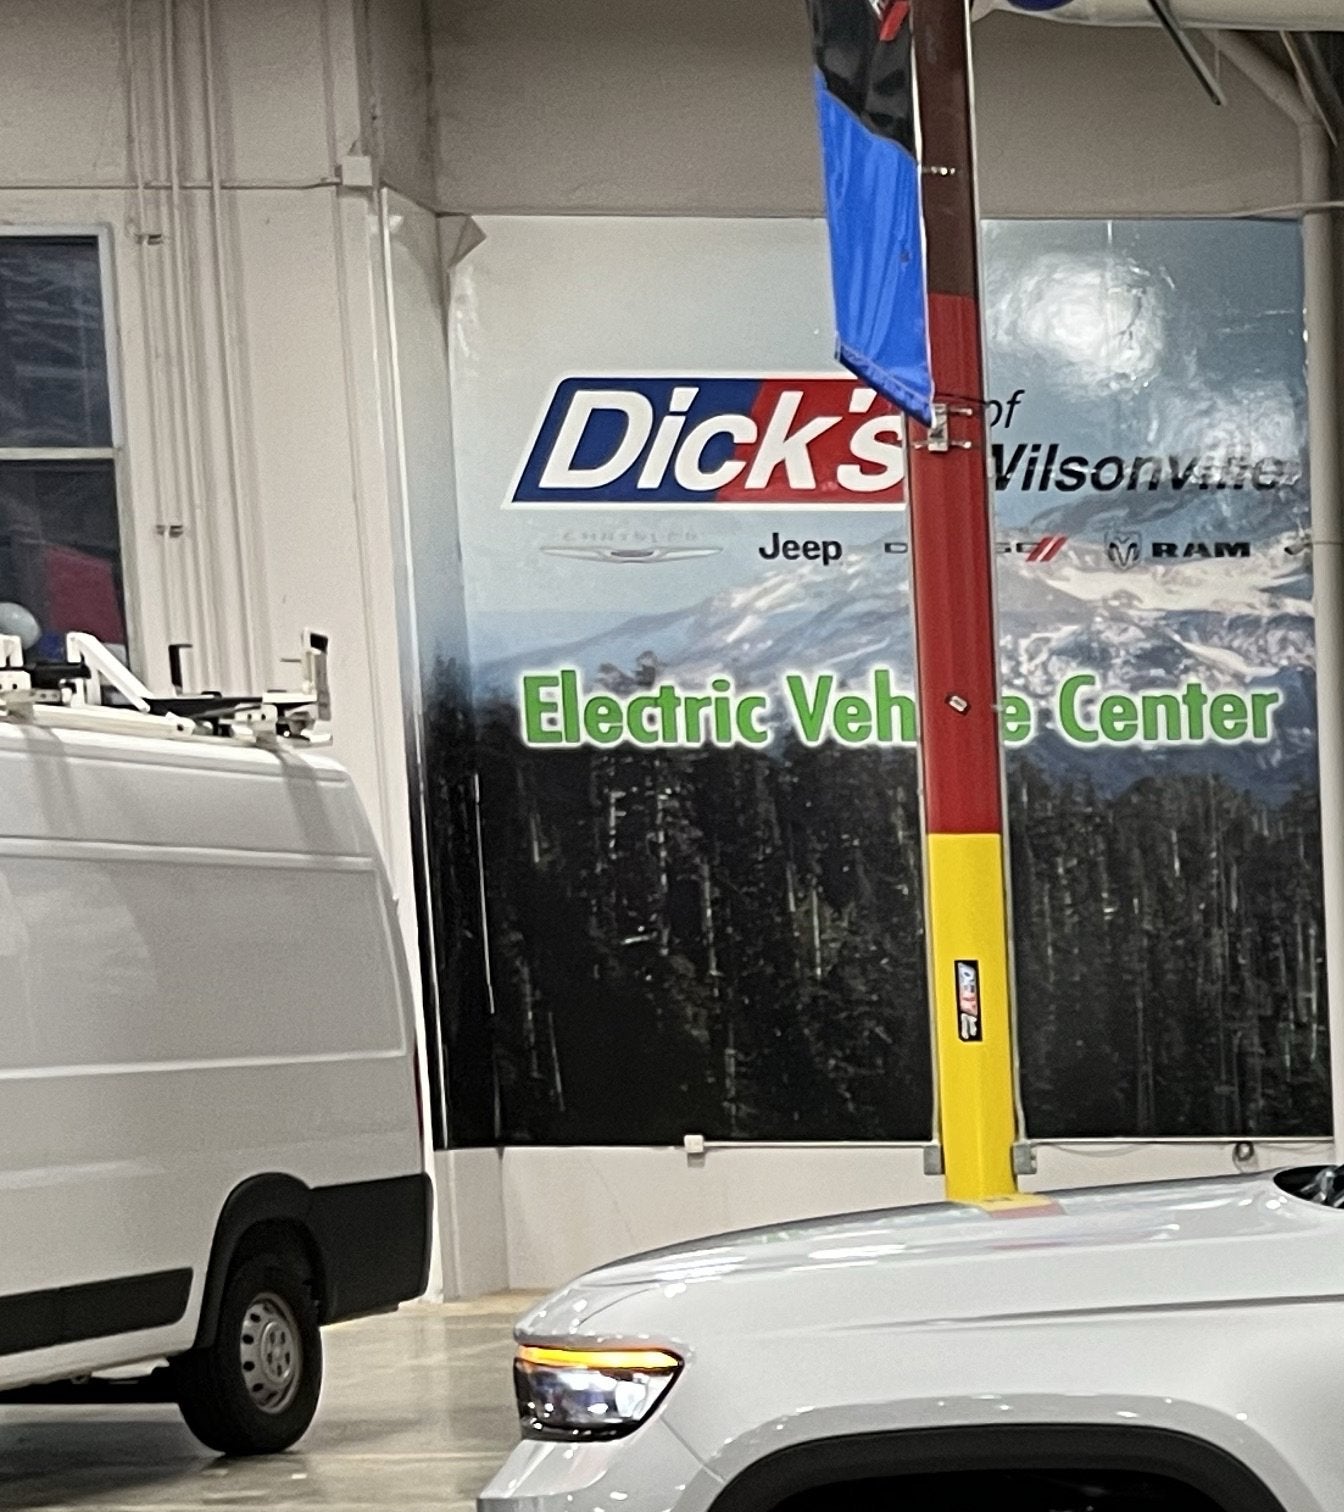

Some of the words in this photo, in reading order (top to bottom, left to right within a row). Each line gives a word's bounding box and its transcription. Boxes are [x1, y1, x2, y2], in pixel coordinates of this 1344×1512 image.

[987, 389, 1025, 428] of
[538, 387, 905, 492] Dick's
[758, 532, 842, 566] Jeep
[1152, 541, 1250, 558] RAM
[523, 670, 768, 744] Electric
[786, 670, 1031, 744] Vehe
[1059, 674, 1279, 742] Center
